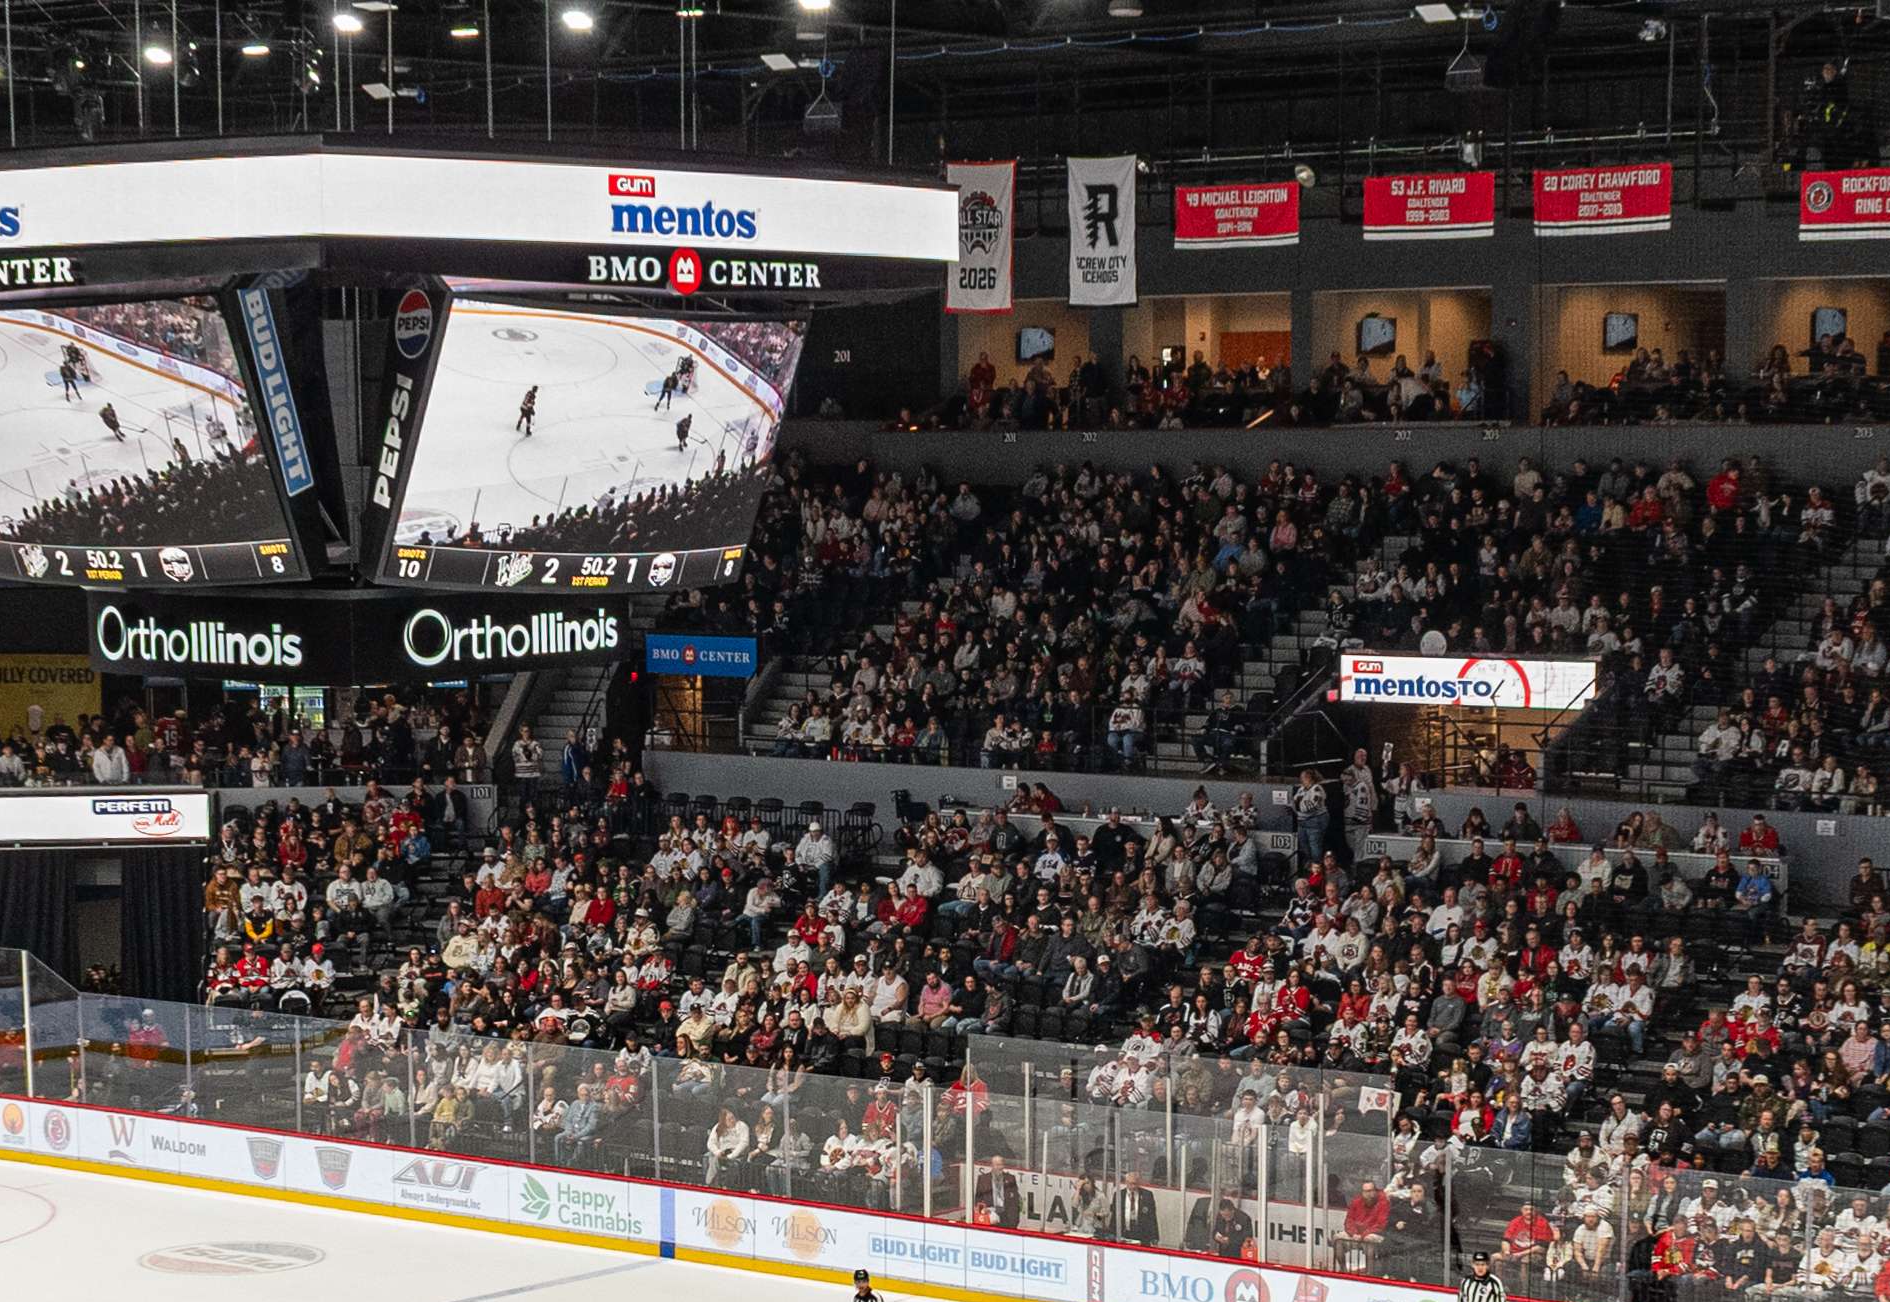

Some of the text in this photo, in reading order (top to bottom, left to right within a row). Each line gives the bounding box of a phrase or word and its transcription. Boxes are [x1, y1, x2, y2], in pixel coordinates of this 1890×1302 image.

[1428, 177, 1466, 194] RIVARD
[1561, 169, 1660, 189] COREY CRAWFORD
[1243, 187, 1288, 205] LEIGHTON
[1855, 198, 1882, 214] RING
[612, 200, 757, 239] mentos
[589, 255, 821, 288] BMO CENTER
[1108, 254, 1127, 270] CITY
[959, 267, 997, 290] 2026
[1082, 269, 1119, 284] ICEHOGS
[397, 312, 431, 331] PEPSI
[245, 290, 305, 484] BUD LIGHT
[373, 373, 413, 509] PEPSI
[55, 550, 74, 576] 2
[86, 549, 124, 570] 50.2
[270, 555, 284, 574] 8
[398, 559, 420, 578] 10
[541, 558, 559, 584] 2
[581, 556, 617, 577] 50.2
[97, 605, 303, 667] OrthoIllinois
[404, 608, 618, 667] OrthoIllinois
[652, 648, 751, 665] BMO CENTER
[28, 667, 95, 685] COVERED
[1354, 675, 1457, 699] mentos
[95, 801, 170, 813] PERFETTI
[151, 1134, 207, 1157] WALDOM
[557, 1182, 615, 1212] Happy
[557, 1204, 642, 1235] Cannabis
[692, 1206, 757, 1236] WILSON
[771, 1215, 838, 1246] WILSON
[871, 1237, 961, 1266] BUD LIGHT
[971, 1250, 1064, 1280] BUD LIGHT
[1140, 1269, 1214, 1302] BMO
